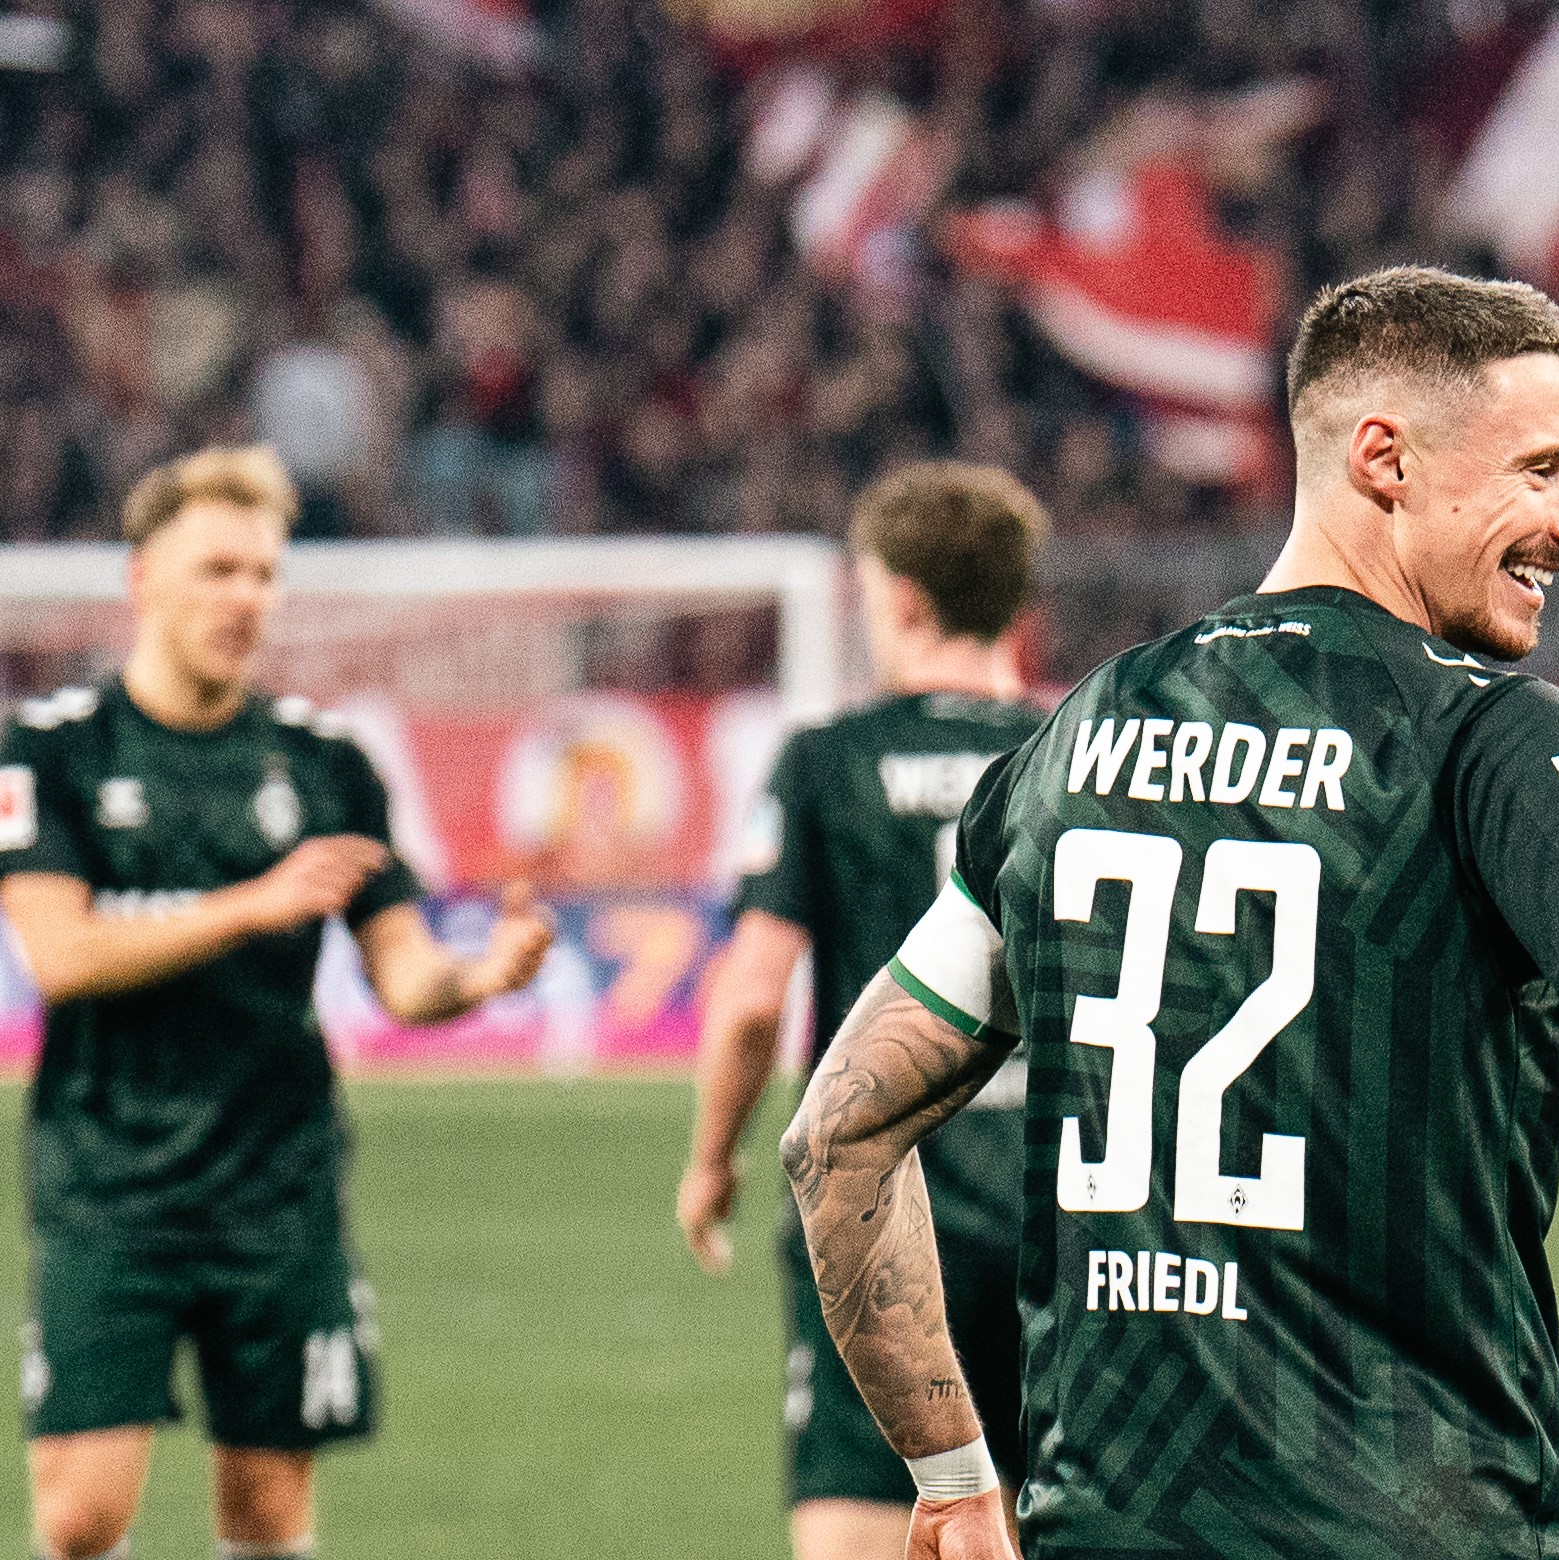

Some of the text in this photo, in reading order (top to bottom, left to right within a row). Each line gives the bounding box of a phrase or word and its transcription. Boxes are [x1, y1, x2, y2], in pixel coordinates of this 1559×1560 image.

[1067, 718, 1354, 811] WERDER
[1055, 830, 1322, 1230] 32
[1088, 1252, 1248, 1320] FRIEDL
